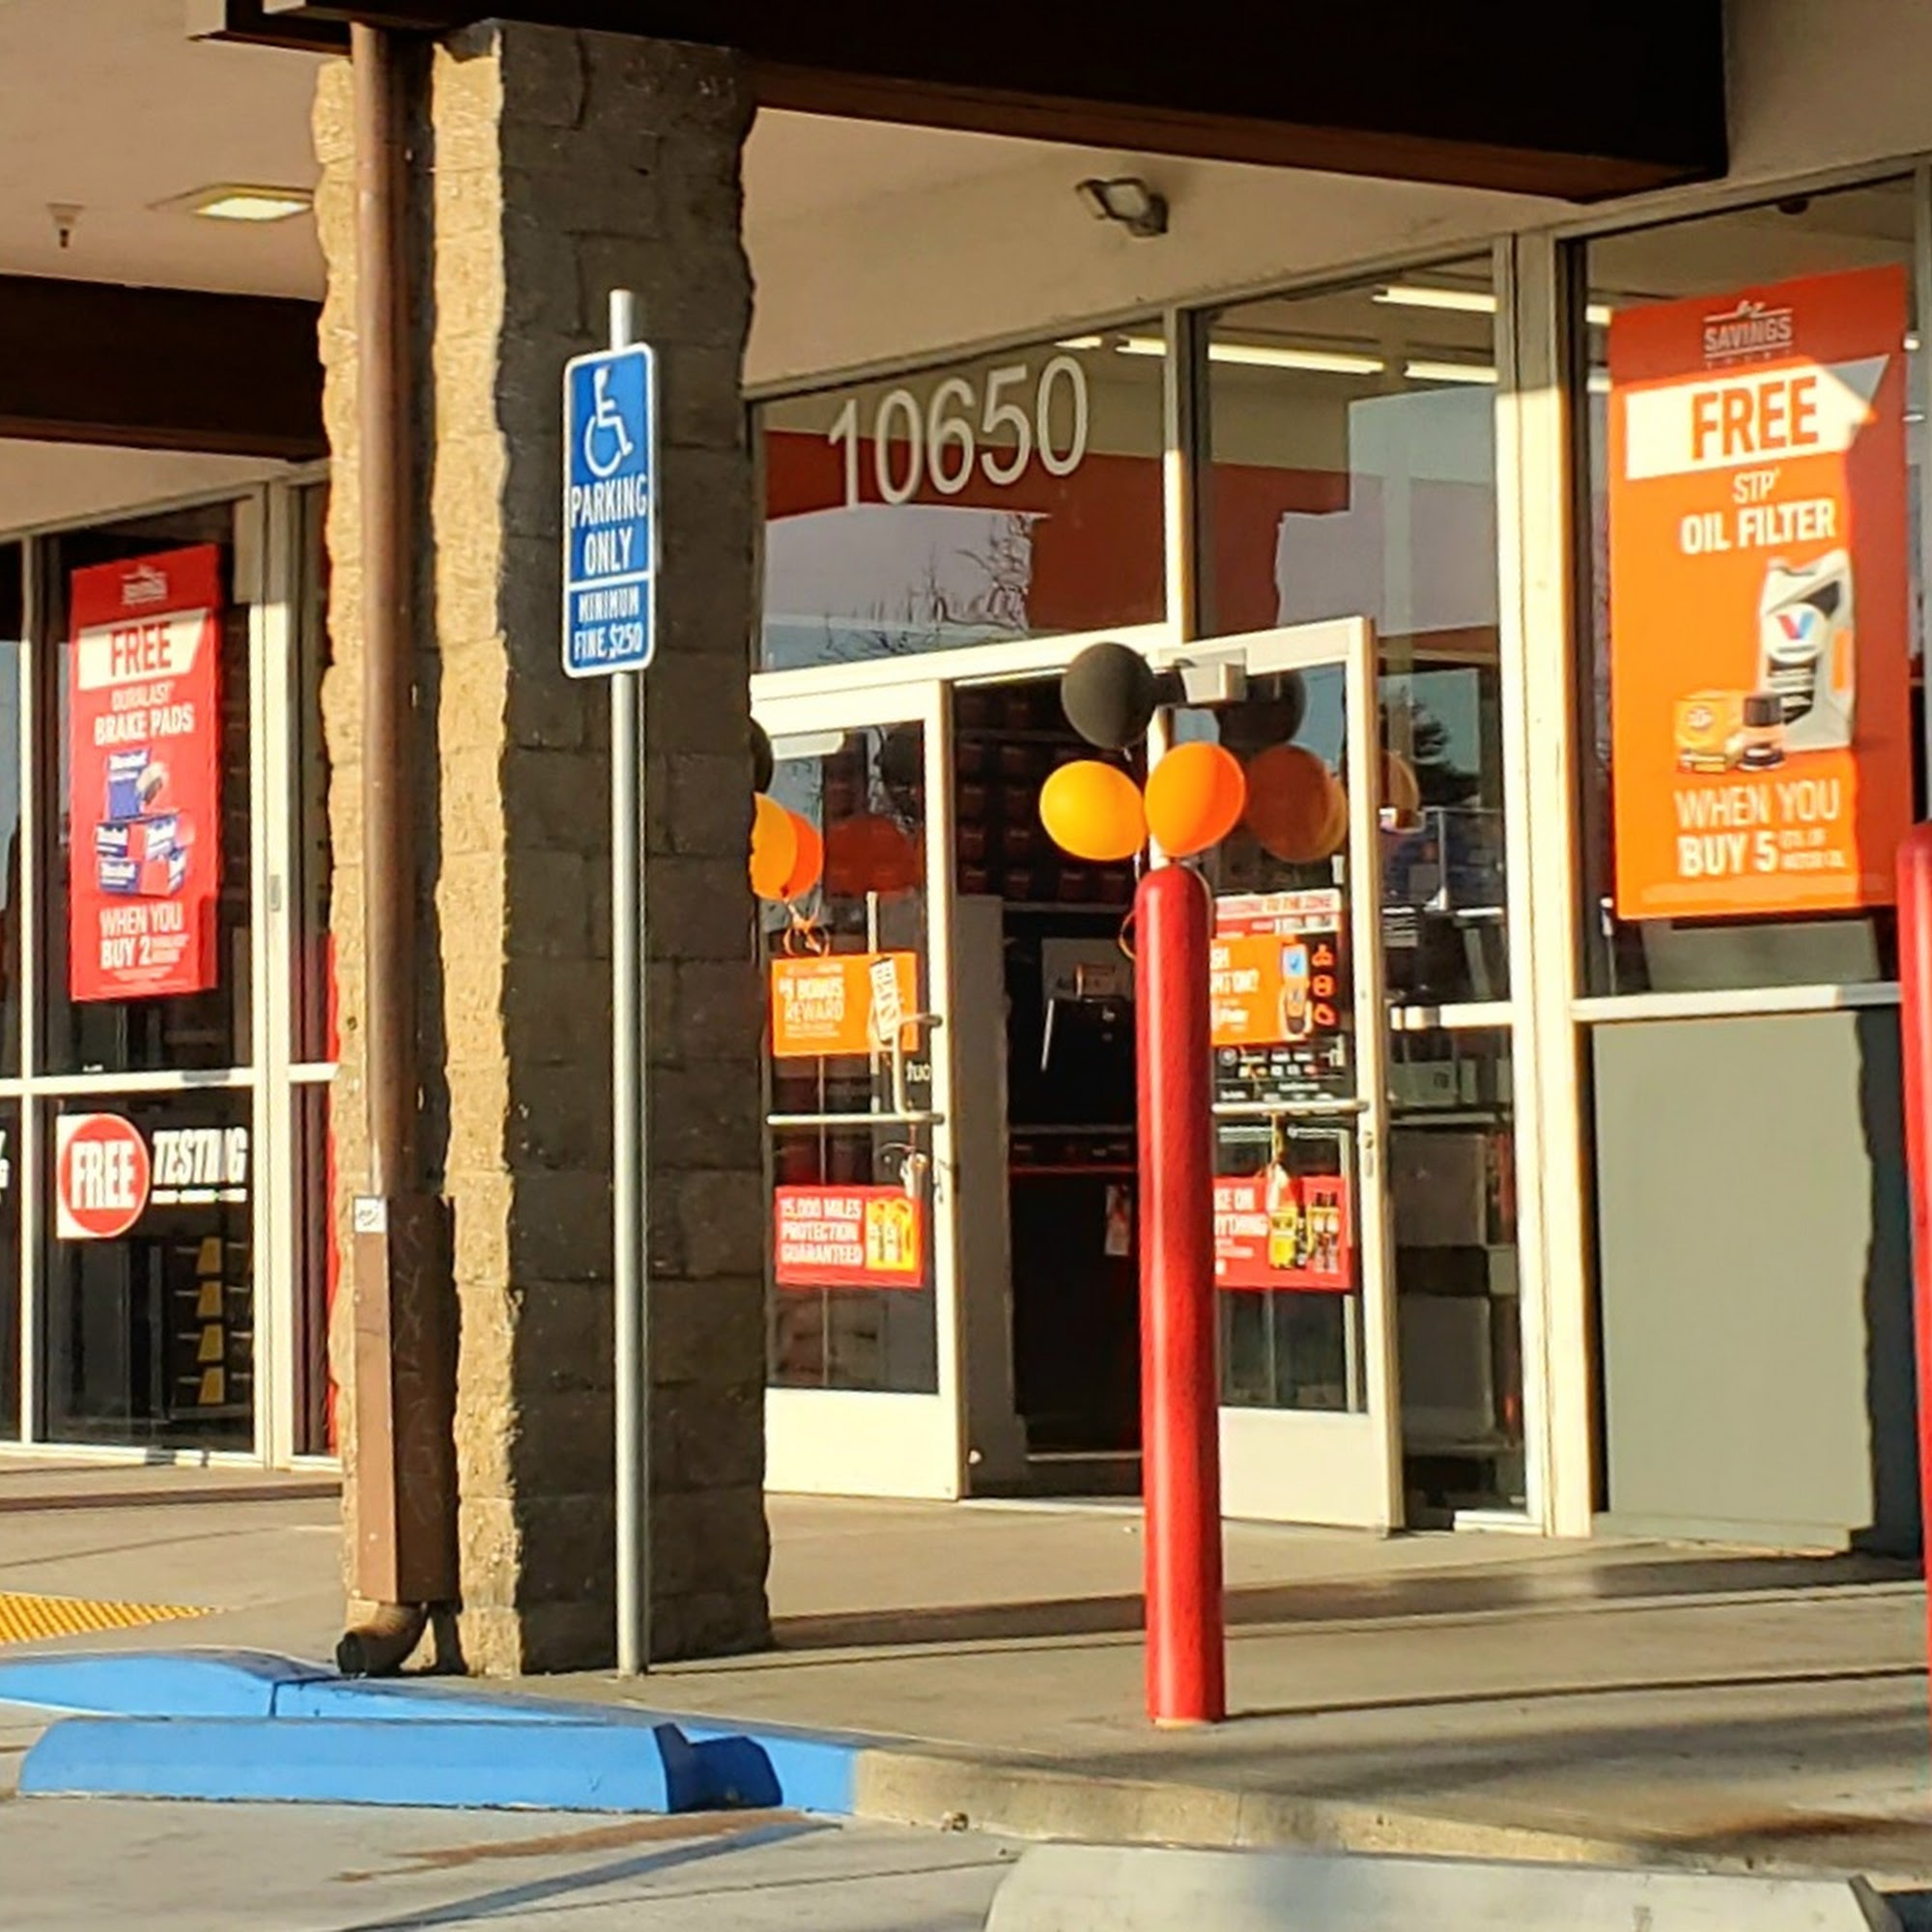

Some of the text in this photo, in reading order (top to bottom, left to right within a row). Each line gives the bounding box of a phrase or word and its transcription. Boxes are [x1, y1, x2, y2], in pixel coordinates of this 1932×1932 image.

[1704, 316, 1792, 353] SAVINGS
[828, 355, 1089, 513] 10650
[1690, 374, 1819, 463] FREE
[571, 472, 647, 529] PARKING
[1734, 471, 1775, 504] STP
[1681, 497, 1836, 554] OIL FILTER
[584, 526, 634, 577] ONLY
[579, 585, 639, 623] MINIMUM
[110, 621, 172, 677] FREE
[574, 621, 643, 662] FINE $250
[94, 701, 195, 747] BRAKE PADS
[1673, 778, 1840, 830] WHEN YOU
[1678, 830, 1777, 879] BUY 5
[99, 899, 184, 938] WHEN YOU
[100, 936, 136, 970] BUY
[138, 933, 151, 966] 2
[71, 1139, 135, 1210] FREE
[781, 1220, 859, 1241] PROTECTION
[823, 1197, 863, 1221] MILES
[781, 1242, 864, 1265] GUARANTEED
